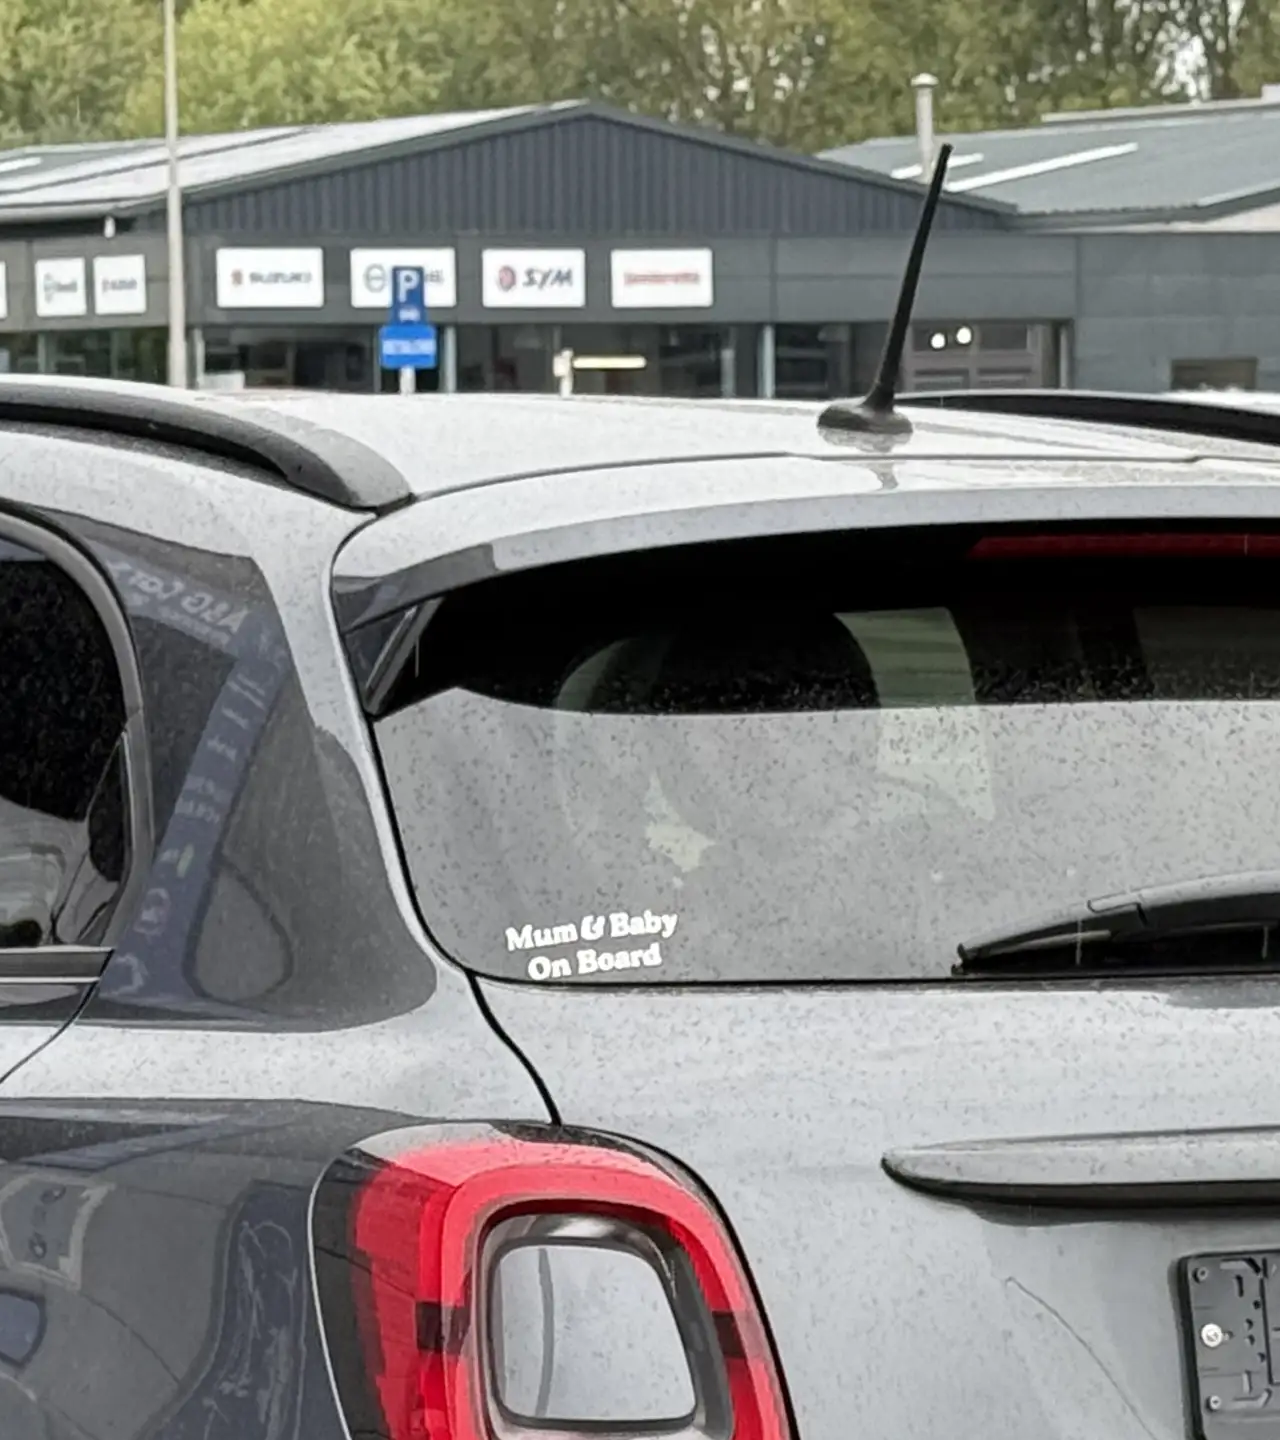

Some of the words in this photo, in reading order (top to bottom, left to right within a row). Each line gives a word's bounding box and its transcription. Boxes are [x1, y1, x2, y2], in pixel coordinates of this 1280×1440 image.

[398, 270, 420, 302] P
[523, 268, 573, 289] SYM
[505, 923, 578, 951] Mum
[580, 915, 605, 940] &
[609, 909, 678, 938] Baby
[528, 956, 571, 980] On
[577, 942, 662, 974] Board
